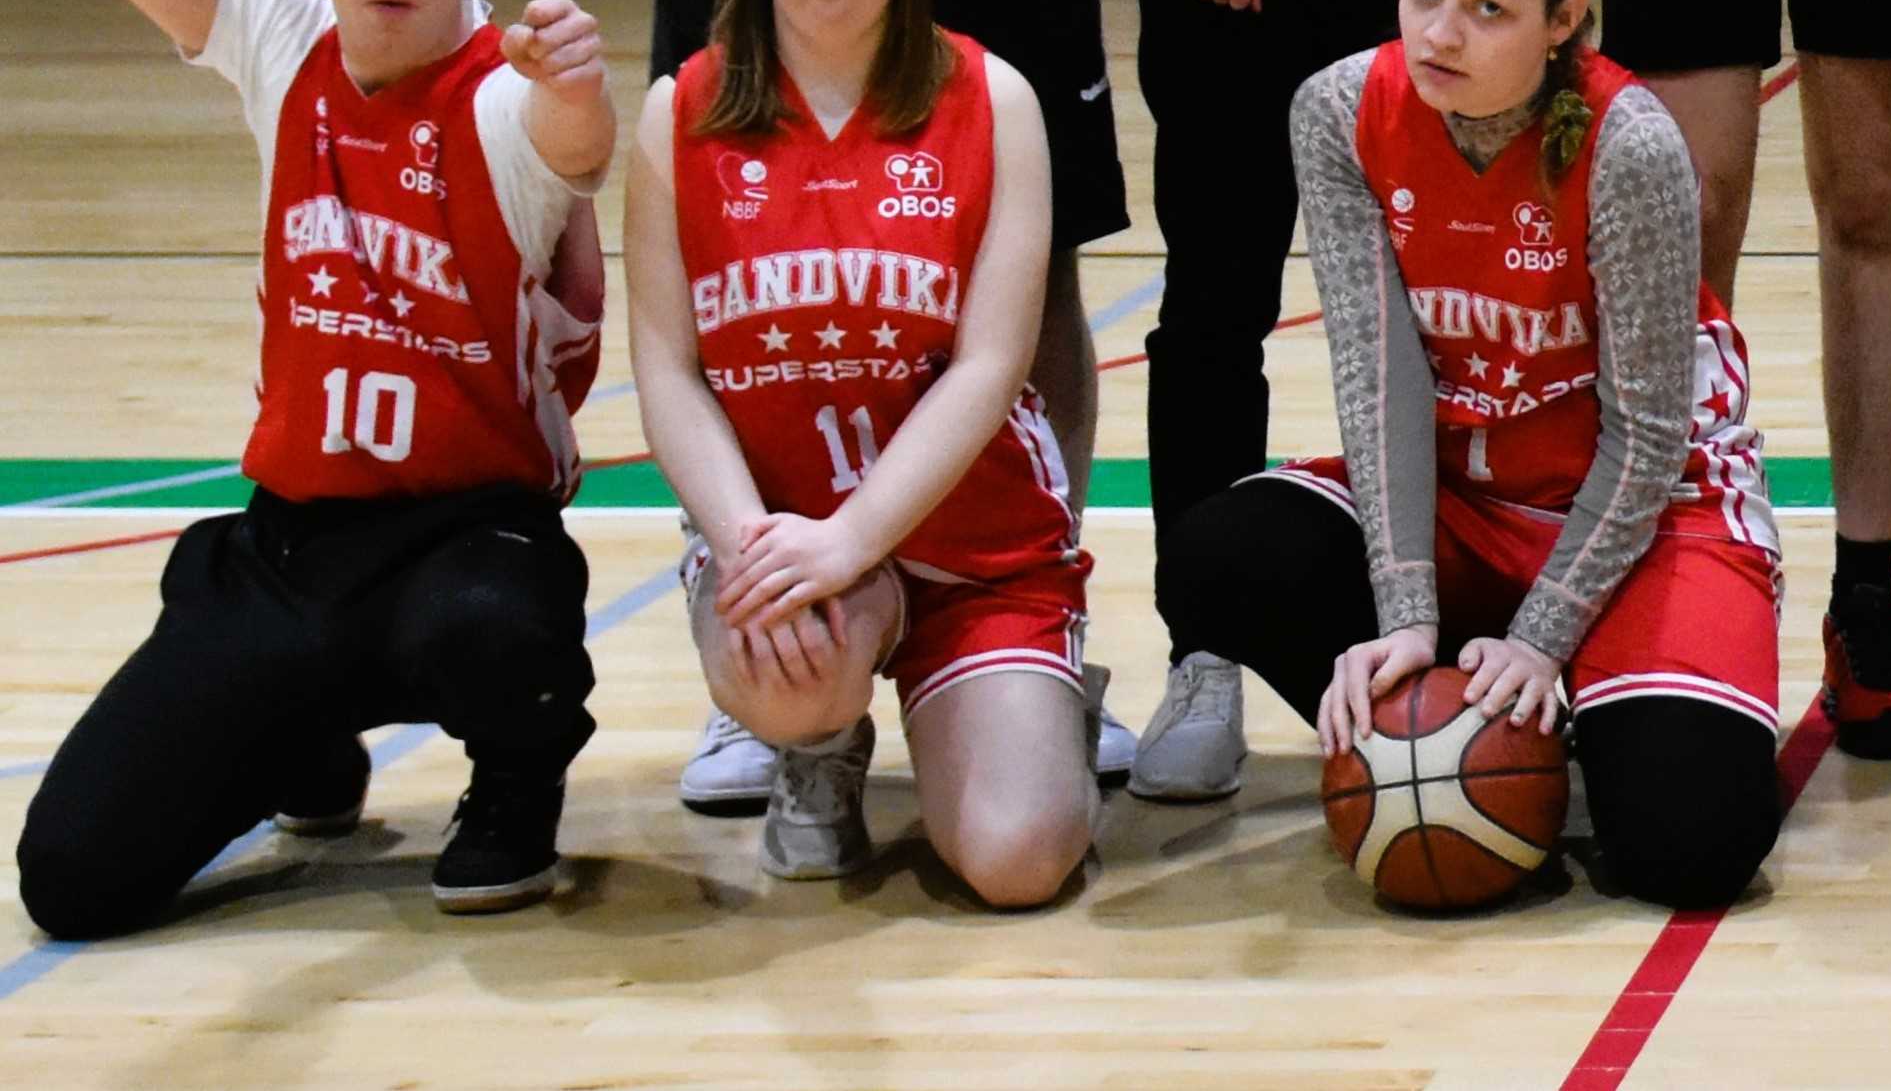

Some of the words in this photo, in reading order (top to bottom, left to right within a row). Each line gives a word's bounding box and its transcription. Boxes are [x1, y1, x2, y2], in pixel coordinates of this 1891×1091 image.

[400, 167, 448, 201] OBS
[722, 201, 763, 220] NBBF
[878, 195, 956, 219] OBOS
[1505, 247, 1568, 272] OBOS
[1407, 286, 1592, 356] NDVIKA
[705, 355, 917, 392] SUPERSTA
[321, 366, 416, 462] 10
[815, 404, 881, 494] 11
